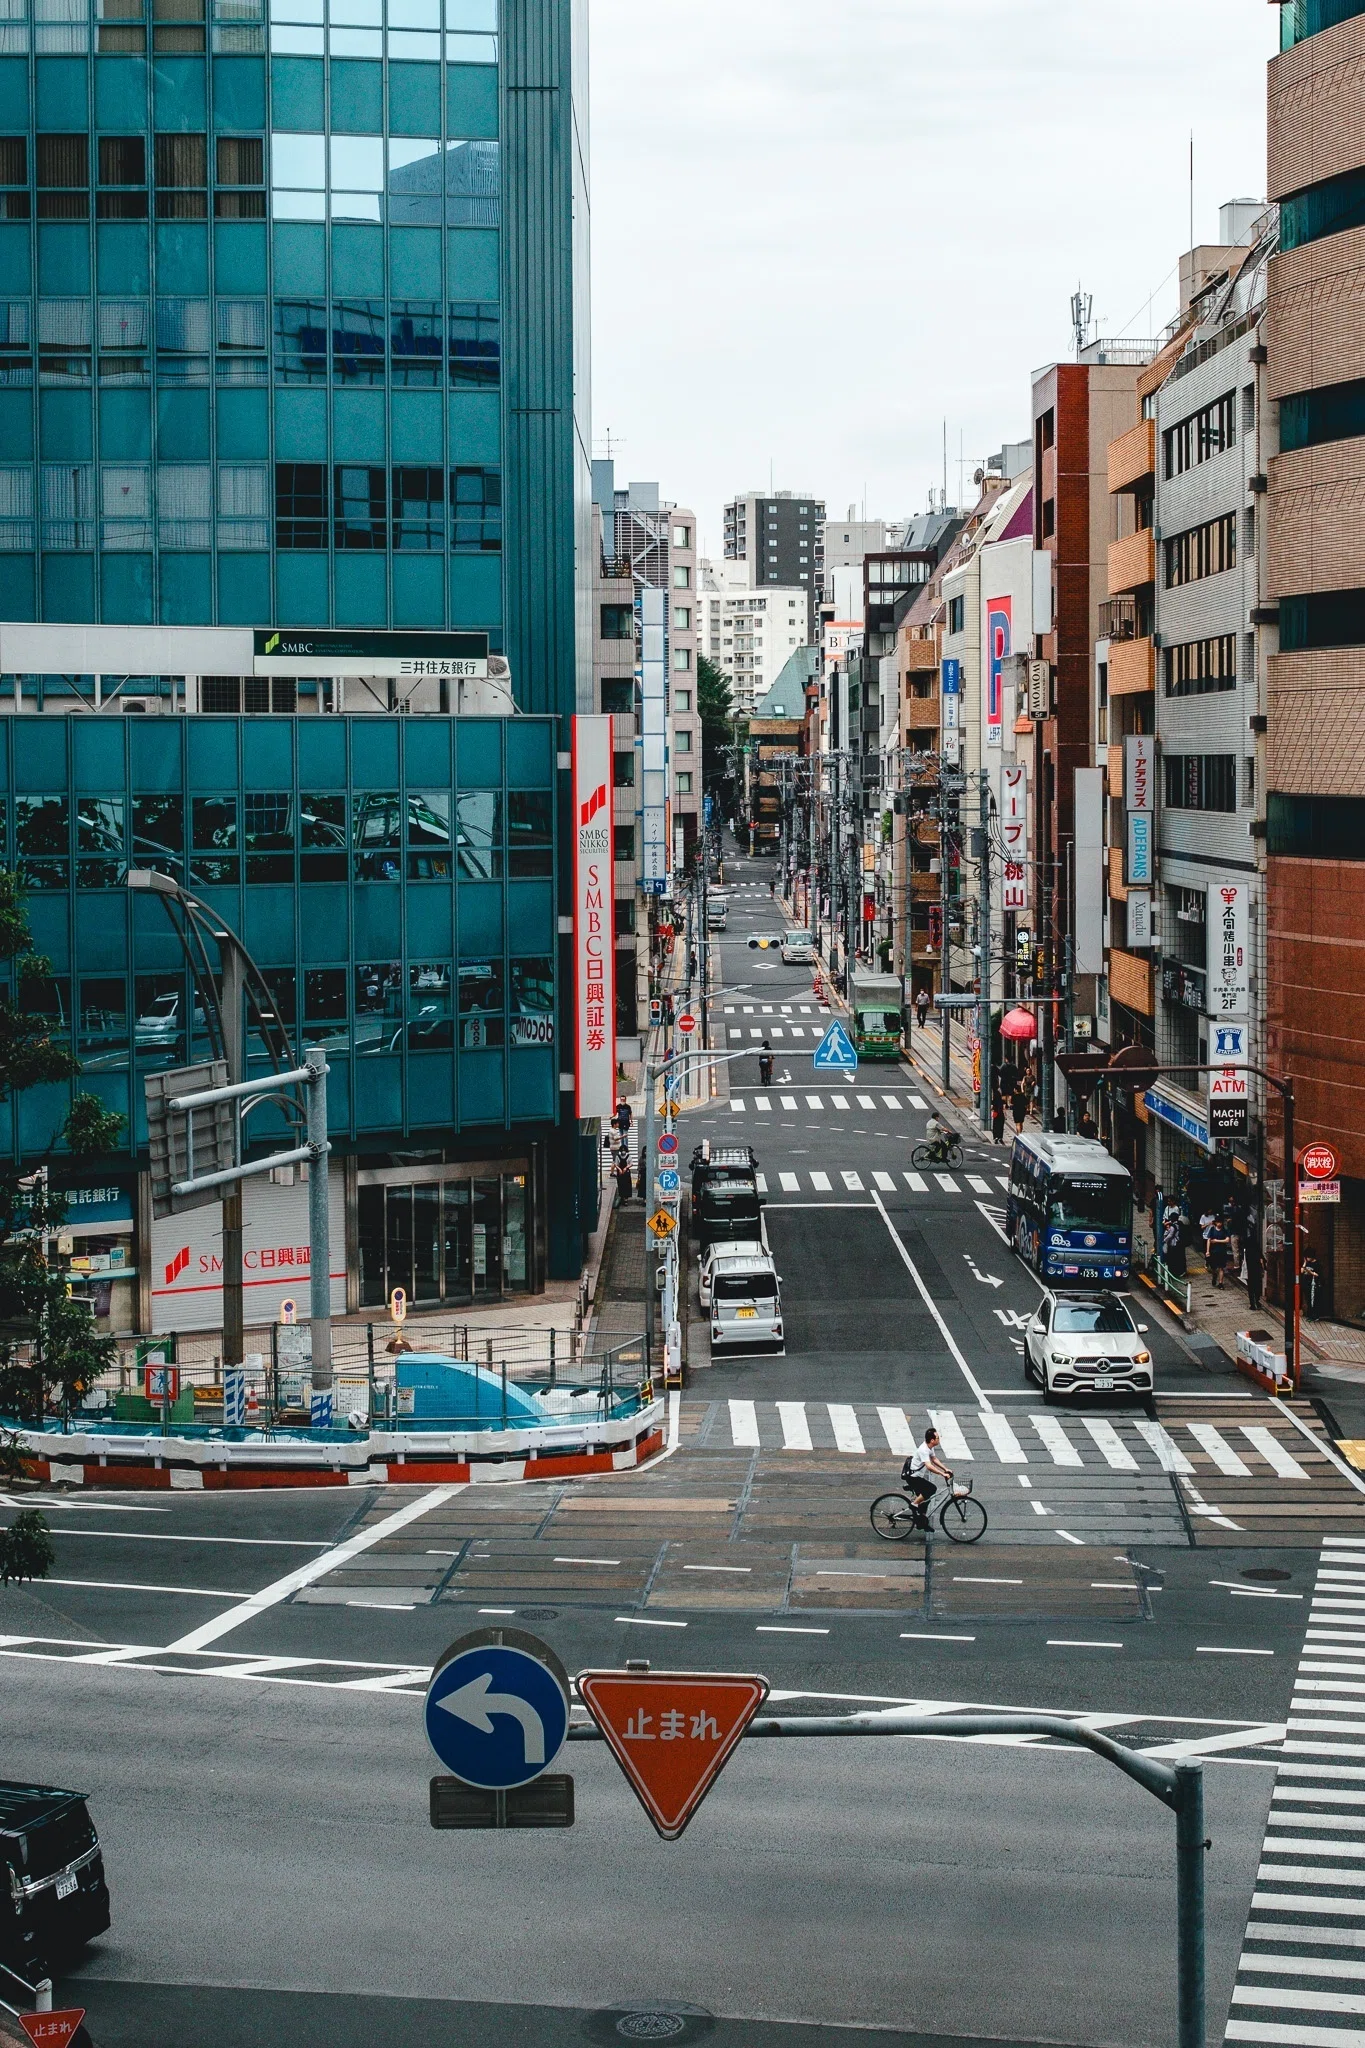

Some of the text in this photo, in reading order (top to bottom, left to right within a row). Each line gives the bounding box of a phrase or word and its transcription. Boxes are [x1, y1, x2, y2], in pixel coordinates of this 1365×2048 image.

[281, 642, 314, 653] SMBC
[829, 636, 850, 648] BL
[399, 661, 477, 675] 三井住友銀行
[1031, 663, 1041, 710] WOWOW
[1034, 711, 1043, 719] 5F
[1133, 758, 1147, 808] アデランス
[1004, 769, 1023, 844] ソープ
[579, 829, 609, 840] SMBC
[579, 840, 609, 848] NIKKO
[1132, 818, 1147, 878] ADERANS
[1004, 863, 1024, 907] 桃山
[1135, 902, 1147, 937] Xanadu
[584, 864, 605, 1051] SMBC日興証券
[1221, 999, 1237, 1010] 2F
[1212, 1081, 1245, 1093] ATM
[1212, 1110, 1245, 1118] MACHI
[1218, 1118, 1240, 1127] café
[1306, 1157, 1332, 1169] 消火栓
[199, 1246, 332, 1273] SMC日興証
[622, 1707, 723, 1741] 止まれ
[33, 2020, 73, 2038] 止まれ
